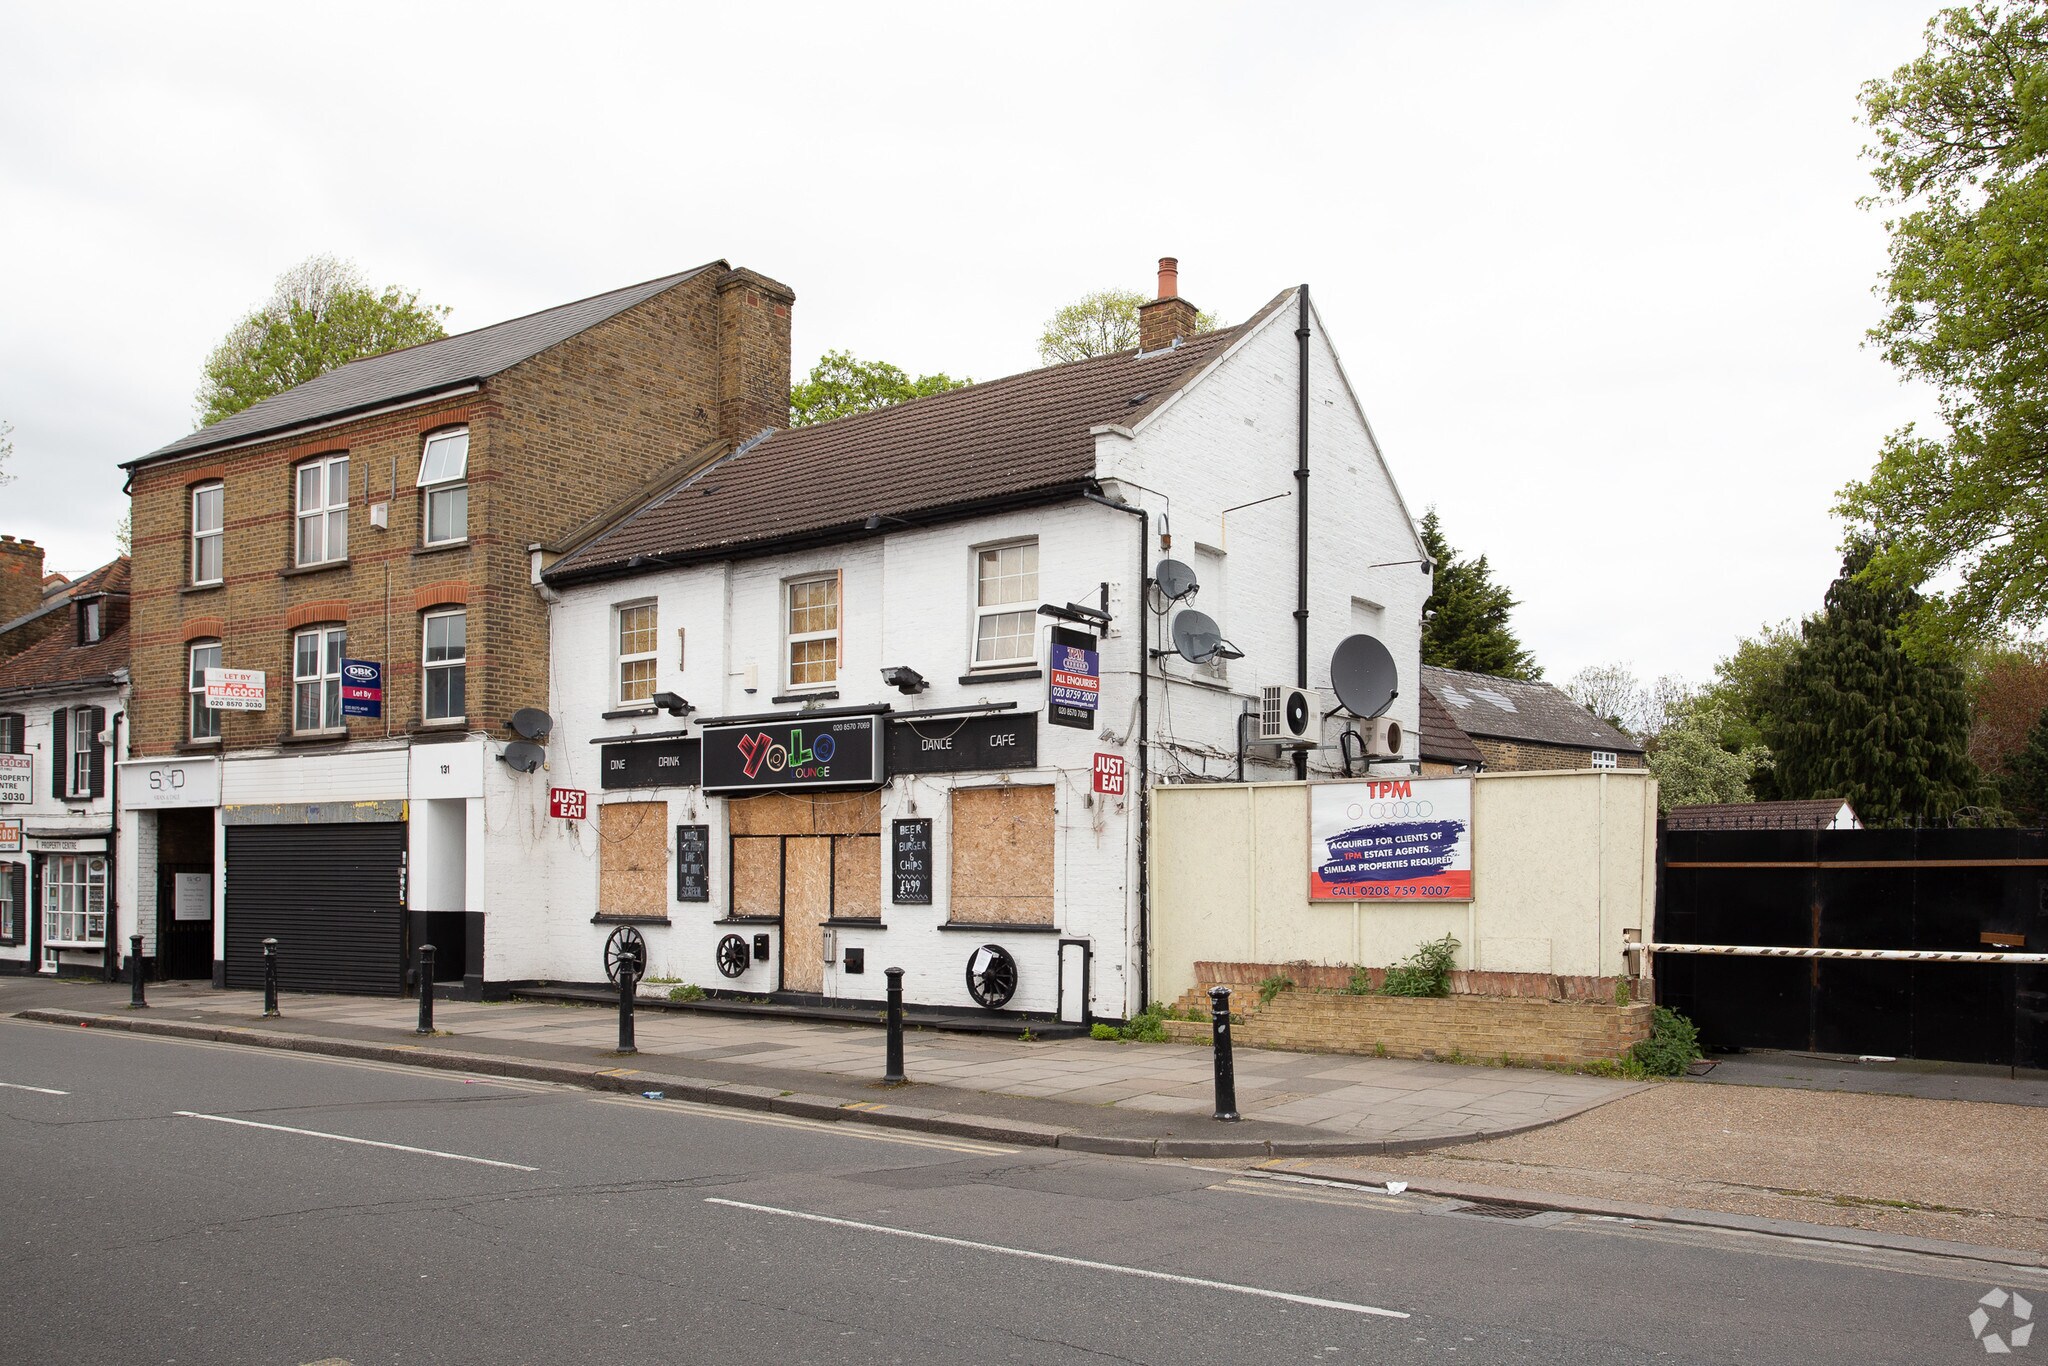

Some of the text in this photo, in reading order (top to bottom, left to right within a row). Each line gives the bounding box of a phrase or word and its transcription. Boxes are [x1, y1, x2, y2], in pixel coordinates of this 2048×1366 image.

[1067, 647, 1084, 661] TPM
[350, 668, 372, 676] DBK
[1056, 674, 1097, 688] ALL ENQUIRIES
[210, 686, 262, 698] MEACOCK
[364, 690, 372, 699] By
[1053, 687, 1097, 702] 020 8759 2007
[1067, 708, 1077, 717] 8570
[922, 734, 1016, 751] DANCE CAFE
[737, 729, 835, 779] YOLO
[440, 765, 450, 774] 131
[610, 756, 680, 770] DINE DRINK
[1096, 756, 1122, 774] JUST
[791, 766, 830, 778] LOUNGE
[1102, 774, 1122, 792] EAT
[1367, 780, 1412, 800] TPM
[2, 792, 25, 801] 3030
[552, 791, 584, 805] JUST
[560, 805, 584, 818] EAT
[900, 825, 922, 835] BEER
[899, 841, 926, 852] BURGER
[1330, 832, 1442, 850] ACQUIRED FOR CLIENTS OF
[1344, 846, 1432, 860] TPM ESTATE AGENTS.
[900, 860, 922, 871] CHIPS
[1324, 856, 1452, 874] SIMILAR PROPERTIES REQUIRED
[900, 880, 920, 894] £4.99
[1332, 886, 1451, 896] CALL 0208 759 2007
